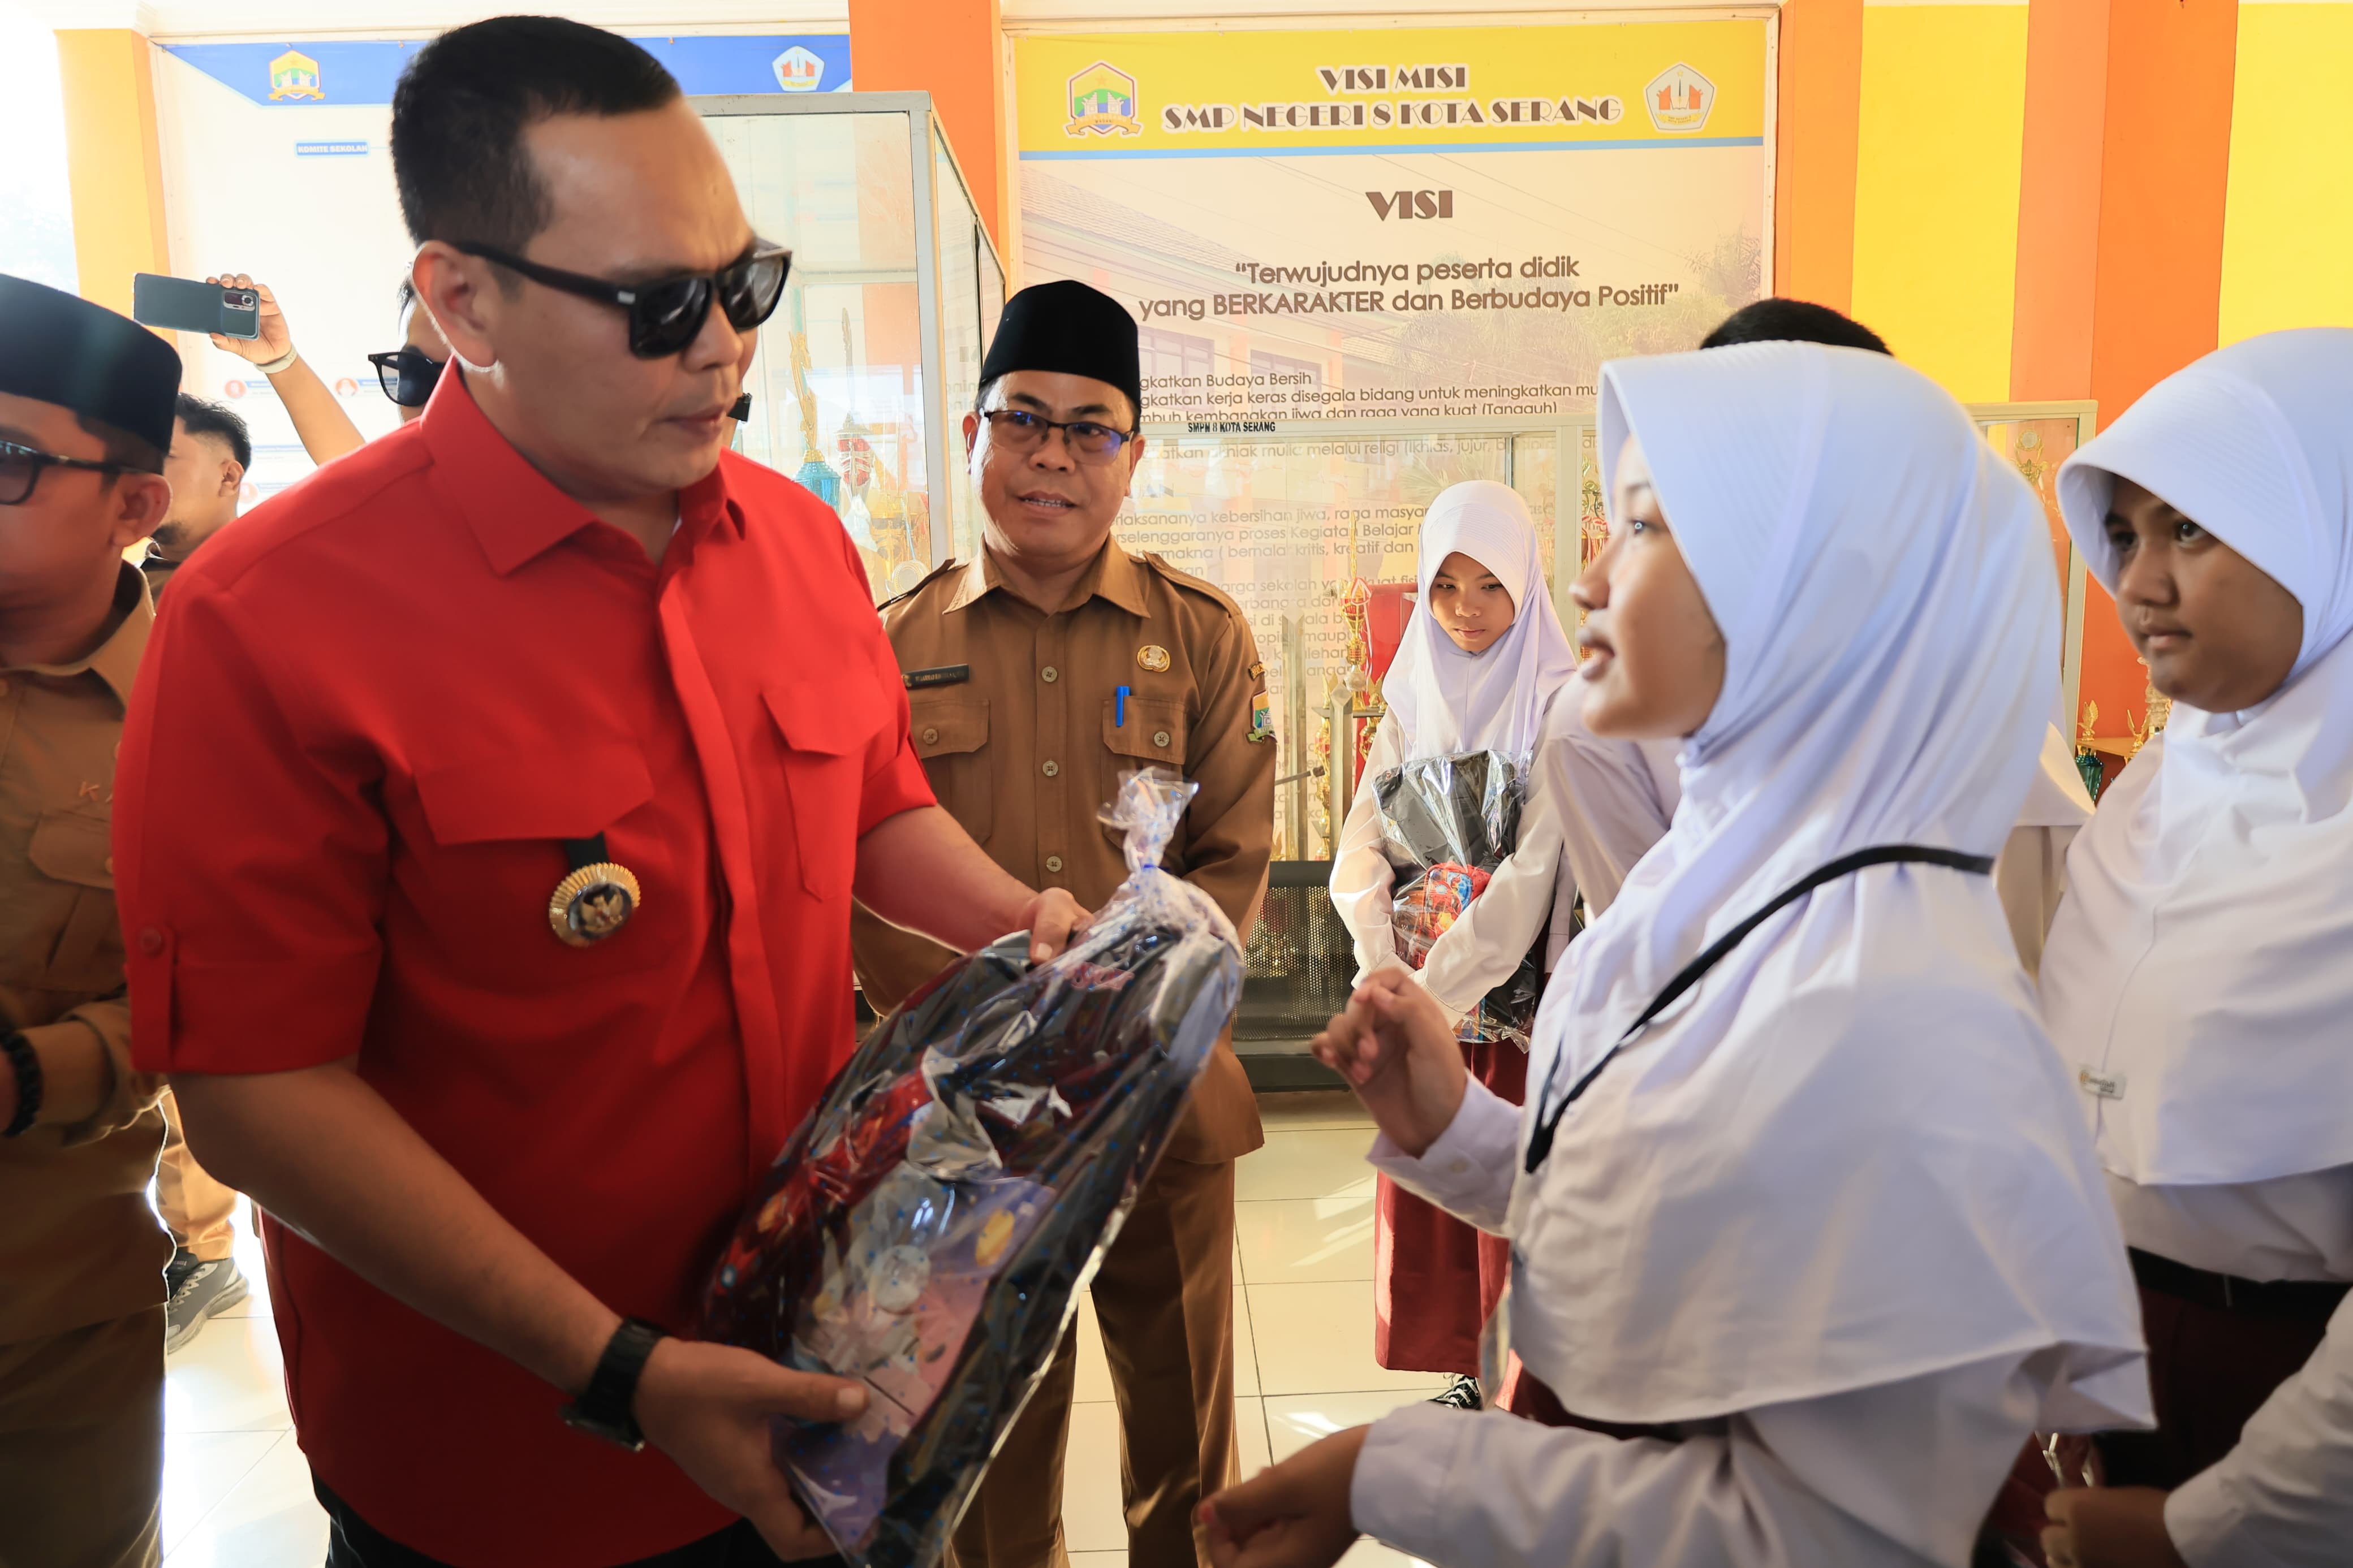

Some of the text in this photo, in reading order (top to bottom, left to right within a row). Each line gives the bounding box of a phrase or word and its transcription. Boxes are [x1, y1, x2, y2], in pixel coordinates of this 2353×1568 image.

[1320, 66, 1466, 91] VISI MISI
[1165, 98, 1622, 129] SMP NEGERI 8 KOTA SERANG
[330, 144, 367, 153] SEKOLAH
[1365, 191, 1454, 221] VISI
[1416, 258, 1512, 284] peserta
[1520, 256, 1580, 278] didik
[1139, 298, 1205, 320] yang
[1213, 292, 1384, 315] BERKARAKTER
[1392, 289, 1444, 312] dan
[1452, 287, 1591, 316] Berbudaya
[1140, 372, 1312, 391] gkatkan Budaya Bersih
[1140, 392, 1201, 409] gkatkan
[1207, 391, 1243, 407] kerja
[1248, 390, 1287, 403] keras
[1291, 388, 1355, 404] disegala
[1360, 388, 1414, 402] bidang
[1419, 386, 1460, 399] untuk
[1464, 384, 1571, 400] meningkatkan
[1326, 407, 1356, 418] dan
[1188, 422, 1210, 433] SMPN
[1219, 422, 1242, 433] KOTA
[1243, 421, 1275, 432] SERANG
[1307, 443, 1360, 457] melalui
[1364, 440, 1399, 457] religi
[1113, 511, 1206, 526] rlaksananya
[1211, 509, 1293, 524] kebersihan
[1296, 508, 1330, 524] jiwa,
[1239, 528, 1286, 543] proses
[1363, 524, 1414, 538] Belajar
[1295, 543, 1329, 556] kritis,
[1384, 541, 1413, 554] dan
